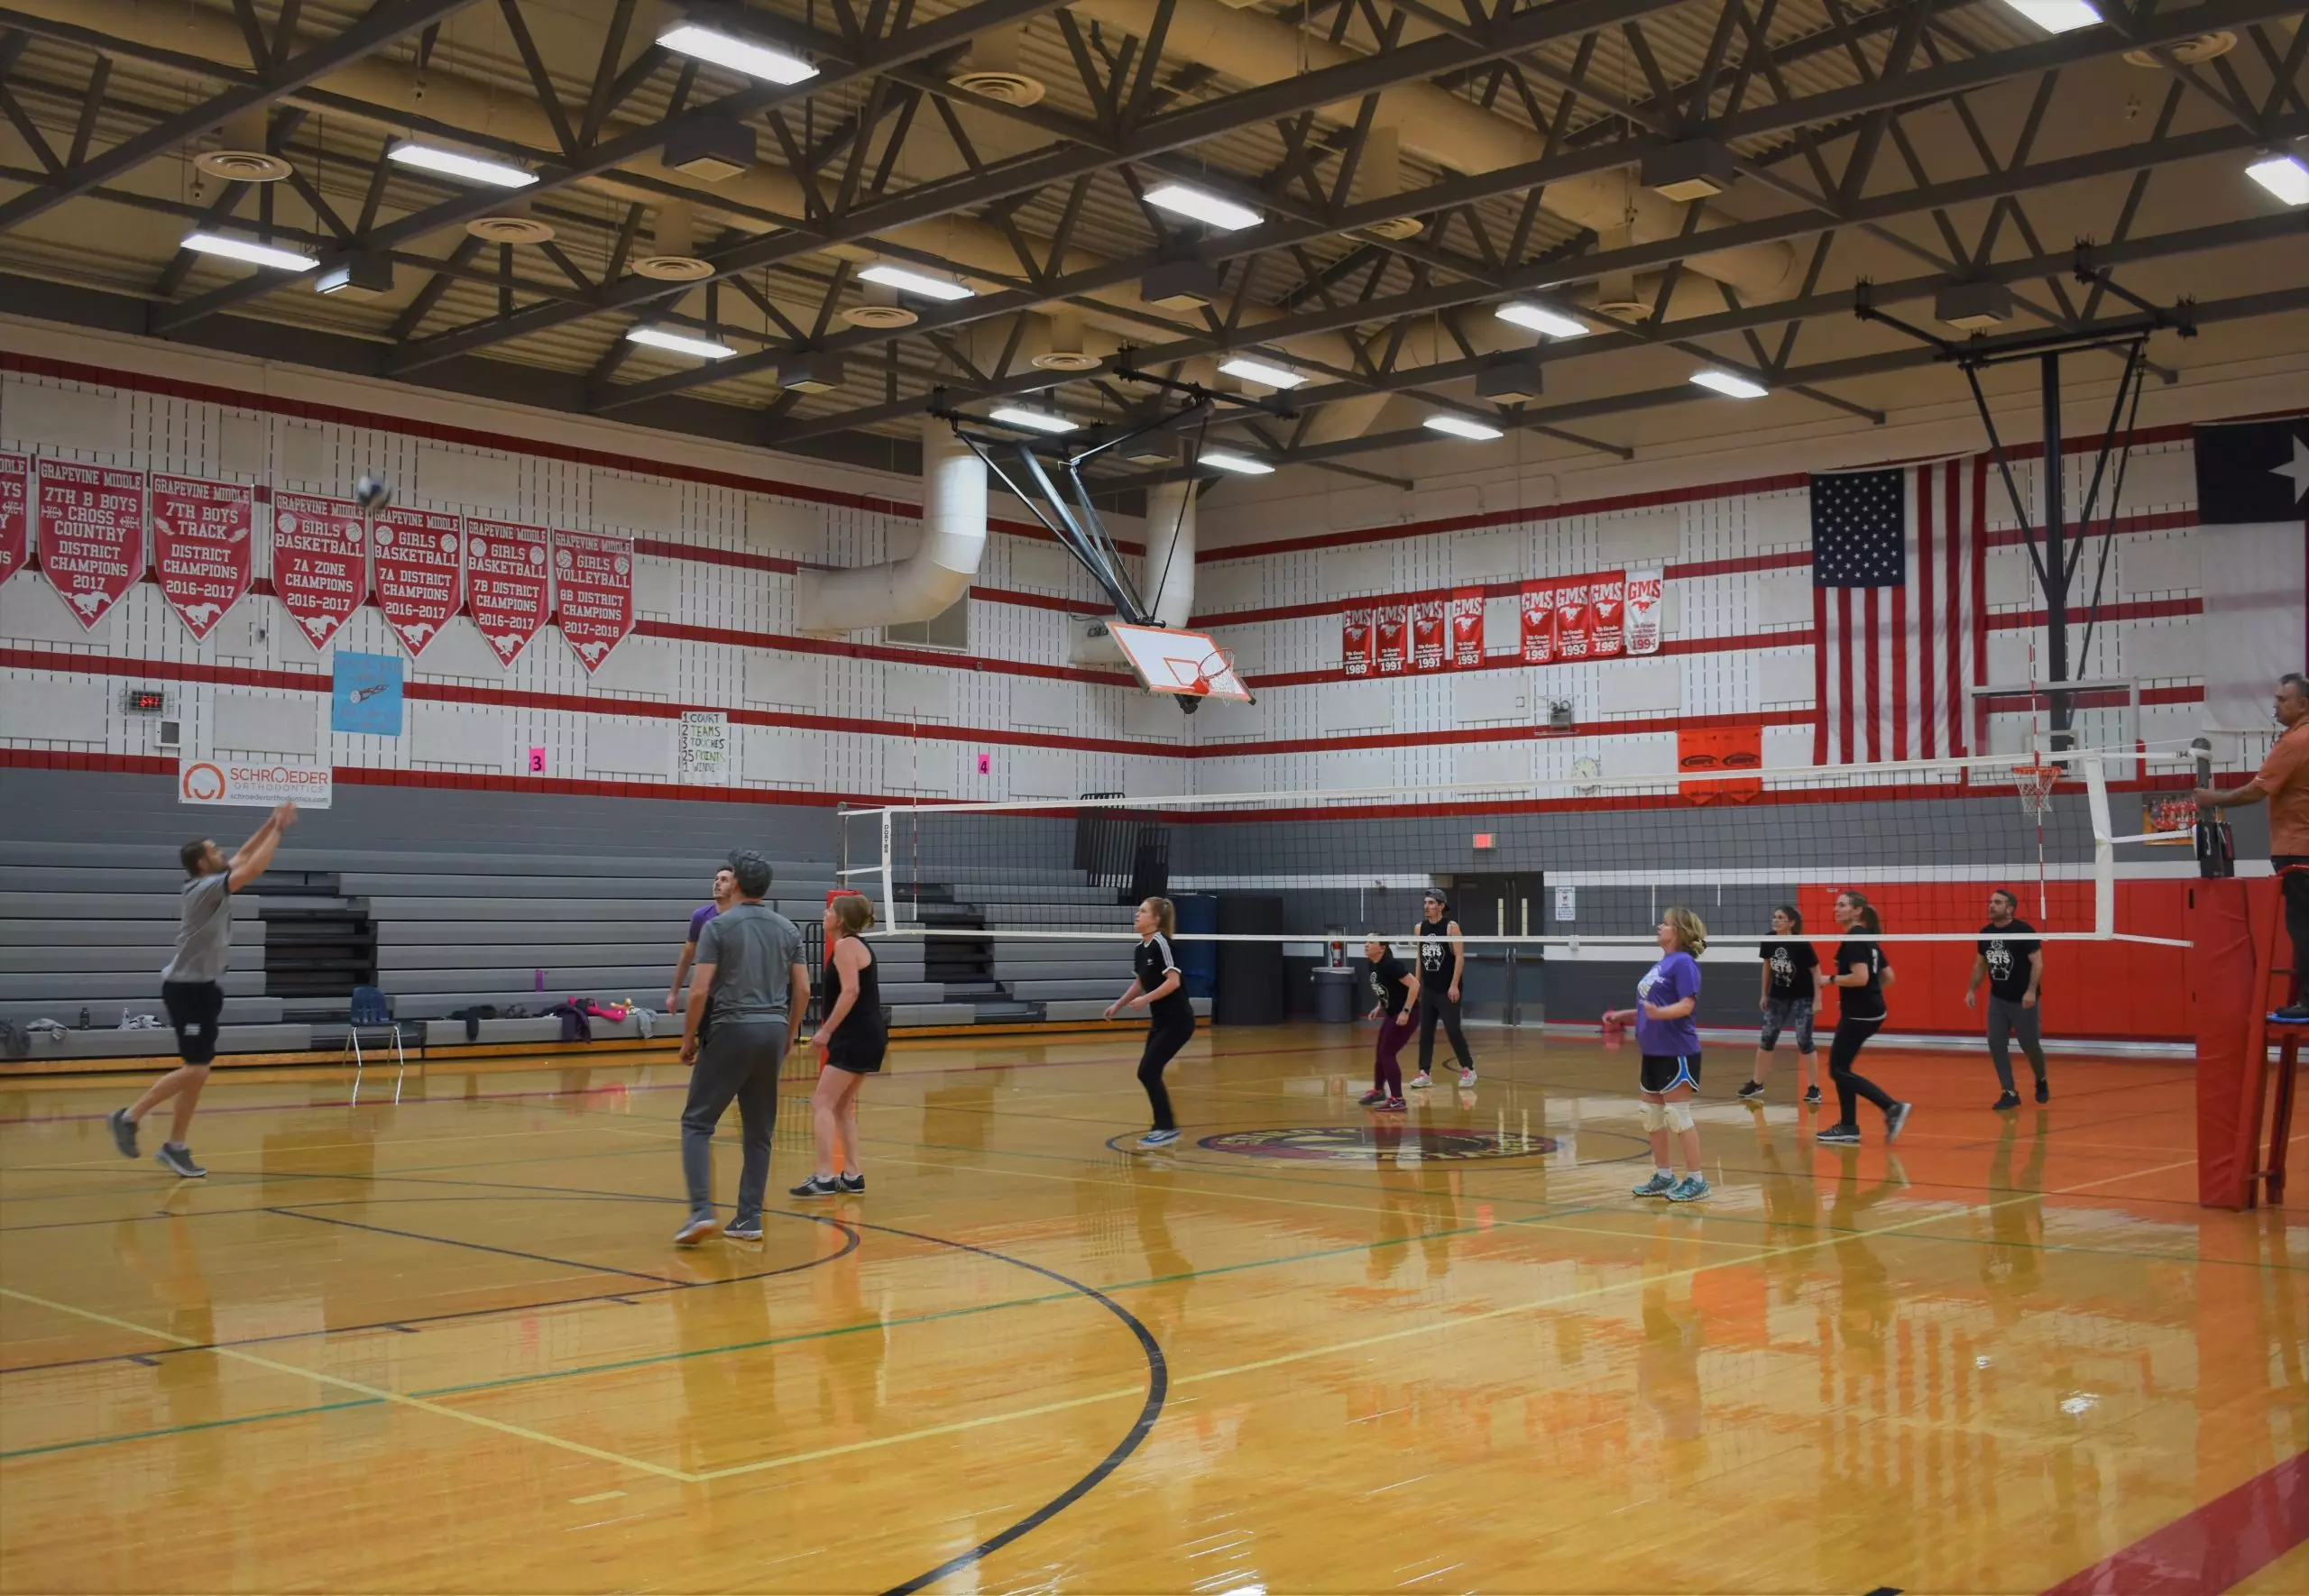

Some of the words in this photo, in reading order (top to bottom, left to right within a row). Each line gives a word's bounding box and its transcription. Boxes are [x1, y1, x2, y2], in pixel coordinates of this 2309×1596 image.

[41, 463, 99, 485] GRAPEVINE
[104, 472, 142, 491] MIDDLE
[45, 487, 76, 505] 7TH
[83, 491, 94, 506] B
[100, 494, 137, 512] BOYS
[154, 478, 209, 499] GRAPEVINE
[213, 487, 250, 504] MIDDLE
[68, 506, 115, 525] CROSS
[166, 501, 196, 519] 7TH
[202, 506, 239, 524] BOYS
[276, 495, 327, 516] GRAPEVINE
[331, 503, 364, 520] MIDDLE
[301, 519, 340, 537] GIRLS
[374, 509, 424, 527] GRAPEVINE
[426, 515, 459, 532] MIDDLE
[54, 520, 127, 543] COUNTRY
[178, 520, 228, 540] TRACK
[469, 521, 514, 540] GRAPEVINE
[517, 527, 547, 544] MIDDLE
[274, 533, 364, 557] BASKETBALL
[399, 531, 437, 548] GIRLS
[556, 533, 599, 551] GRAPEVINE
[601, 539, 630, 555] MIDDLE
[59, 540, 121, 560] DISTRICT
[171, 544, 231, 563] DISTRICT
[374, 545, 458, 567] BASKETBALL
[491, 544, 526, 561] GIRLS
[51, 556, 129, 577] CHAMPIONS
[163, 560, 238, 580] CHAMPIONS
[293, 558, 309, 573] 7A
[314, 561, 346, 576] ZONE
[468, 556, 547, 579] BASKETBALL
[577, 555, 611, 571] GIRLS
[72, 575, 106, 592] 2017
[285, 573, 354, 593] CHAMPIONS
[380, 568, 395, 581] 7A
[400, 570, 452, 587] DISTRICT
[556, 568, 630, 589] VOLLEYBALL
[166, 580, 235, 600] 2016-2017
[382, 583, 448, 601] CHAMPIONS
[474, 579, 489, 592] 7B
[492, 581, 540, 599] DISTRICT
[560, 589, 574, 601] 8B
[577, 591, 624, 607] DISTRICT
[1556, 585, 1587, 607] GMS
[1590, 582, 1623, 603] GMS
[1628, 579, 1660, 601] GMS
[287, 593, 351, 611] 2016-2017
[385, 601, 446, 619] 2016-2017
[476, 595, 538, 612] CHAMPIONS
[1452, 597, 1483, 619] GMS
[1522, 590, 1553, 612] GMS
[563, 603, 621, 621] CHAMPIONS
[1413, 600, 1443, 622] GMS
[479, 613, 535, 630] 2016-2017
[565, 621, 620, 638] 2017-2018
[1346, 663, 1367, 674] 1989
[1380, 661, 1402, 672] 1991
[1418, 656, 1440, 668] 1991
[1458, 655, 1479, 665] 1993
[683, 712, 689, 723] 1
[690, 713, 720, 724] COURT
[682, 724, 688, 736] 2
[690, 725, 721, 738] TEAMS
[682, 737, 688, 749] 3
[533, 756, 542, 771] 3
[682, 749, 695, 762] 25
[230, 766, 328, 784] SCHROEDER
[980, 761, 988, 775] 4
[234, 782, 324, 793] ORTHODONTICS
[230, 793, 328, 803] schroederorthodontics.com
[1422, 948, 1441, 957] SETS
[1987, 954, 2010, 964] SETS
